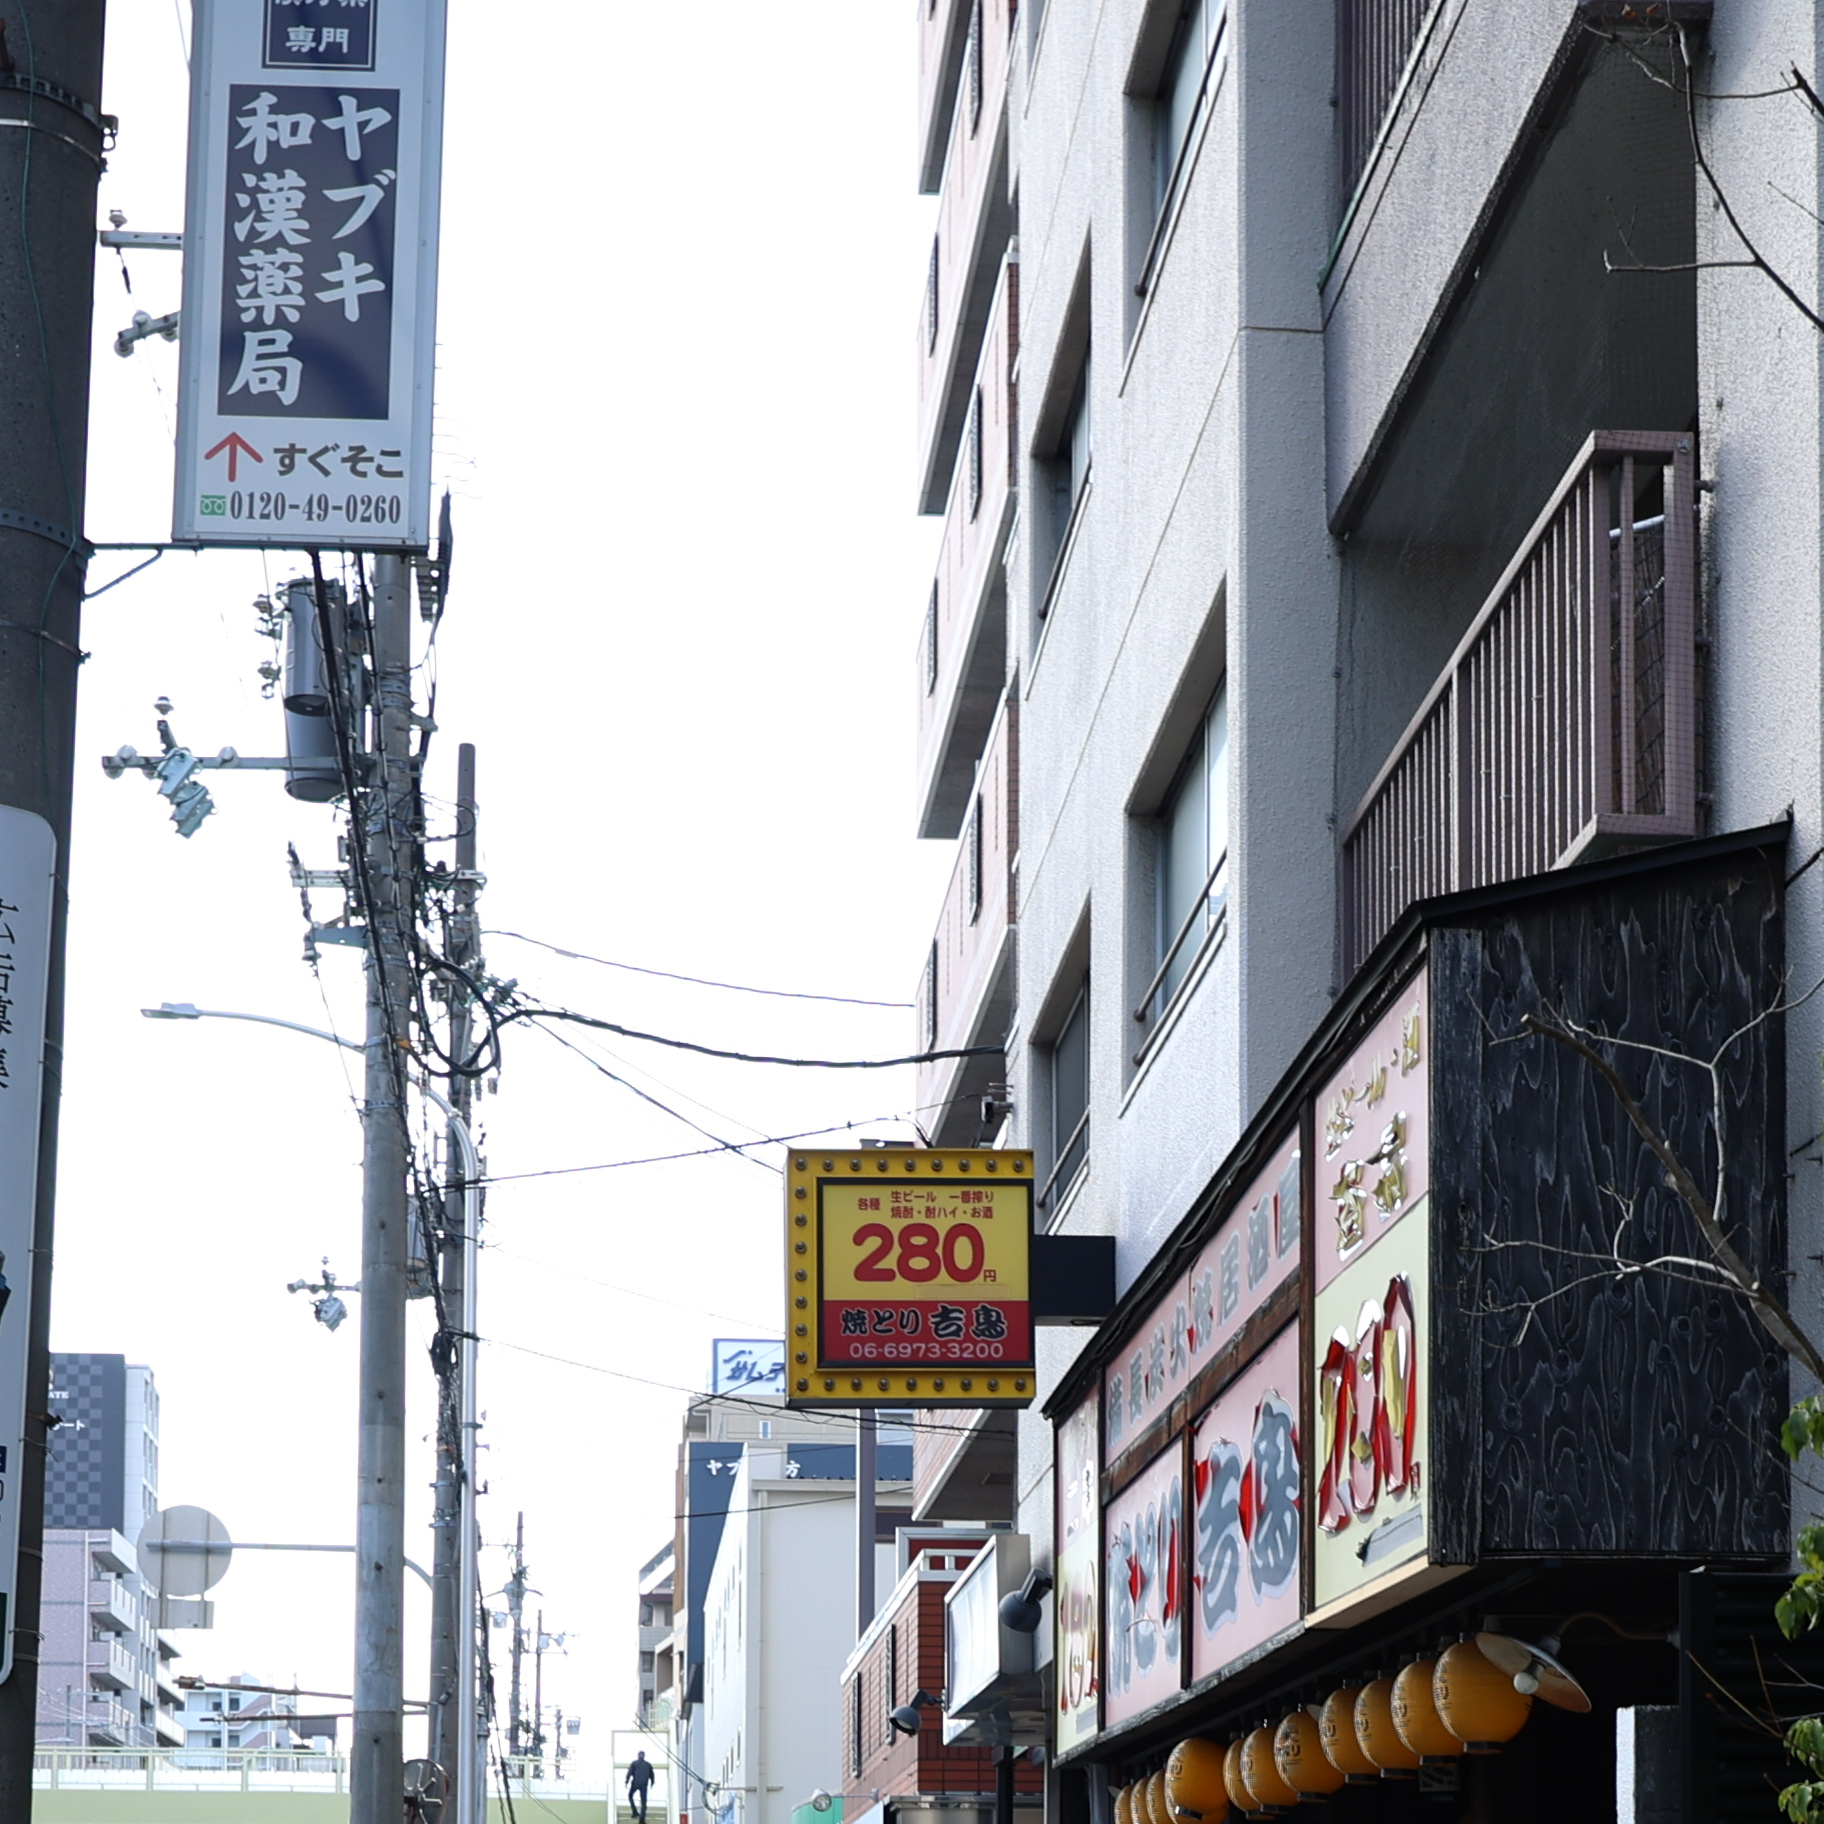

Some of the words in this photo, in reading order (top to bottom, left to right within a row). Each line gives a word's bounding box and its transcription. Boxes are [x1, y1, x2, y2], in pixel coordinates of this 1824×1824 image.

[285, 25, 349, 54] 専門
[316, 94, 396, 322] ヤブキ
[227, 92, 315, 406] 和漢薬局
[274, 442, 404, 480] すぐそこ
[229, 490, 401, 525] 0120-49-0260
[858, 1198, 880, 1211] 各種
[891, 1190, 936, 1203] 生ビール
[949, 1190, 994, 1204] 一番搾り
[891, 1206, 993, 1219] 焼酎・酎ハイ・お酒
[841, 1307, 922, 1336] 焼とり
[850, 1342, 1004, 1358] 06-6973-3200
